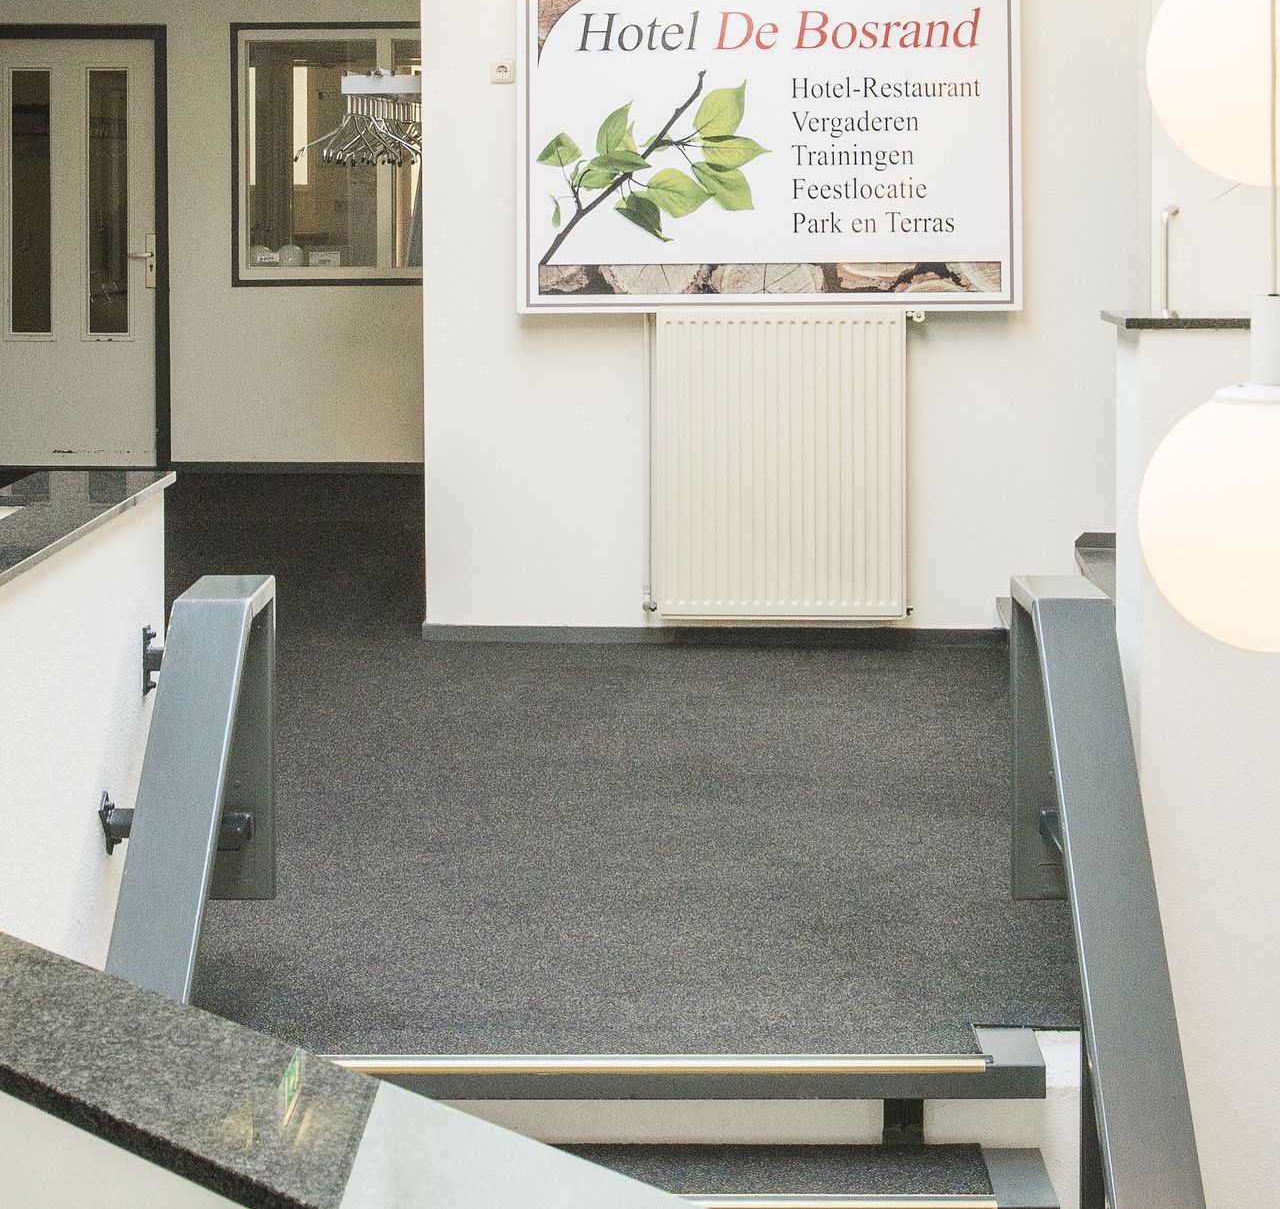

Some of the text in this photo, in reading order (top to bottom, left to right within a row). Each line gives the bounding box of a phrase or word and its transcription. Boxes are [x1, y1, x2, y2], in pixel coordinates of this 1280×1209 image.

[577, 7, 981, 52] Hotel De Bosrand
[791, 76, 981, 99] Hotel-Restaurant
[791, 110, 919, 138] Vergaderen
[791, 143, 914, 172] Trainingen
[792, 176, 927, 200] Feestlocatie
[792, 211, 955, 234] Park en Terras
